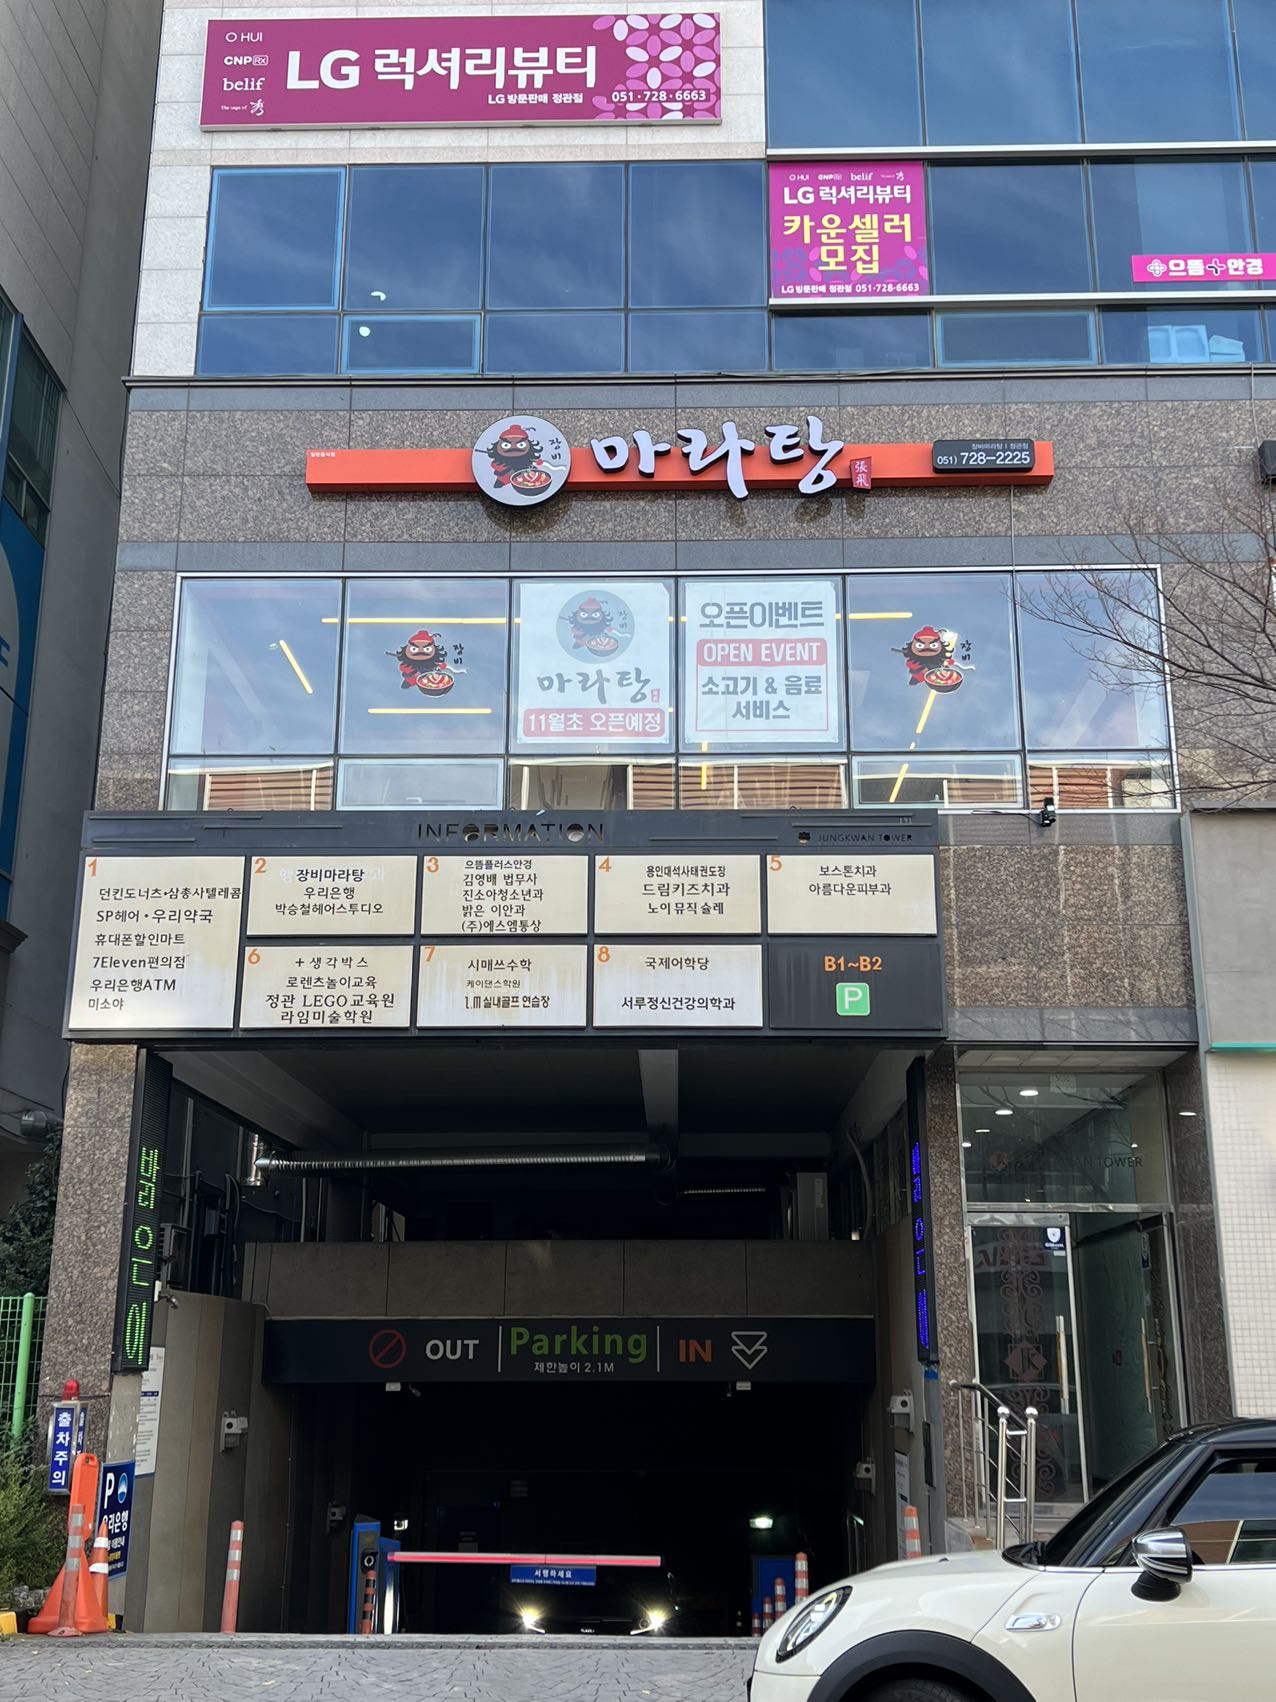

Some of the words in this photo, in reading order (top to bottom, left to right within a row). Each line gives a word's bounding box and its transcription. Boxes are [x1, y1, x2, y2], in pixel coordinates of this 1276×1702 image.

[240, 32, 263, 42] HUI
[286, 50, 360, 90] LG
[373, 45, 597, 90] 럭셔리뷰티
[222, 78, 266, 91] belif
[488, 94, 505, 104] LG
[507, 93, 548, 104] 방문판매
[552, 92, 584, 104] 정관점
[612, 90, 706, 102] 051·728·6663
[850, 172, 874, 181] belif
[784, 187, 815, 204] LG
[818, 184, 912, 205] 럭셔리뷰티
[783, 213, 912, 244] 카운셀러
[818, 244, 880, 275] 모집
[1168, 258, 1204, 276] 으뜸
[1226, 258, 1264, 276] 안경
[781, 284, 794, 294] LG
[855, 283, 920, 292] 051·728·6663
[548, 438, 562, 460] 장비
[590, 414, 845, 500] 마라탕
[936, 456, 958, 465] 051)
[960, 452, 1030, 464] 728-2225
[699, 600, 825, 630] 오픈이벤트
[452, 643, 464, 665] 장비
[704, 644, 754, 664] OPEN
[760, 642, 820, 664] EVENT
[960, 640, 972, 660] 장비
[536, 666, 650, 706] 마라탕
[701, 676, 758, 698] 소고기
[764, 677, 778, 696] &
[784, 675, 822, 696] 음료
[732, 700, 791, 722] 서비스
[528, 712, 584, 734] 11월초
[590, 712, 662, 734] 오픈예정
[417, 823, 604, 842] INFORMATION
[818, 834, 874, 842] JUNGKWAN
[876, 832, 912, 842] TOWER
[88, 858, 98, 877] 1
[255, 858, 266, 874] 2
[426, 858, 440, 873] 3
[464, 860, 532, 870] 으뜸플러스안경
[598, 856, 612, 872] 4
[770, 856, 782, 872] 5
[296, 869, 365, 882] 장비마라탕
[646, 866, 726, 878] 용인대석사태권도장
[819, 866, 877, 878] 보스톤치과
[464, 874, 497, 886] 김영배
[504, 874, 538, 886] 법무사
[304, 887, 355, 900] 우리은행
[462, 889, 544, 902] 진소아청소년과
[642, 883, 730, 896] 드림키즈치과
[809, 883, 892, 896] 아름다운피부과
[276, 903, 384, 916] 박승철헤어스투디오
[462, 904, 484, 918] 밝은
[490, 904, 526, 917] 이안과
[648, 903, 671, 914] 노이
[674, 902, 698, 914] 뮤직
[96, 910, 140, 922] SP헤어
[152, 909, 213, 924] 우리약국
[462, 920, 542, 932] (주)에스엠통상
[94, 933, 186, 946] 휴대폰할인마트
[248, 948, 260, 965] 6
[424, 946, 436, 962] 7
[598, 946, 610, 962] 8
[92, 956, 186, 969] 7Eleven편의점
[310, 957, 368, 970] 생각박스
[468, 959, 532, 972] 시매쓰수학
[645, 957, 709, 970] 국제어학당
[824, 956, 882, 972] B1~B2
[90, 979, 176, 992] 우리은행ATM
[286, 976, 377, 990] 로렌츠놀이교육
[88, 998, 124, 1010] 미소야
[266, 994, 296, 1008] 정관
[484, 996, 520, 1008] 실내골프
[522, 996, 550, 1008] 연습장
[622, 997, 736, 1010] 서루정신건강의학과
[844, 987, 863, 1010] P
[281, 1010, 372, 1024] 라임미술학원
[425, 1340, 480, 1360] OUT
[510, 1326, 648, 1364] Parking
[678, 1340, 712, 1362] IN
[584, 1362, 614, 1372] 2.1M
[52, 1412, 72, 1486] 출차주의
[104, 1472, 115, 1510] P
[534, 1568, 572, 1578] 서행하세요
